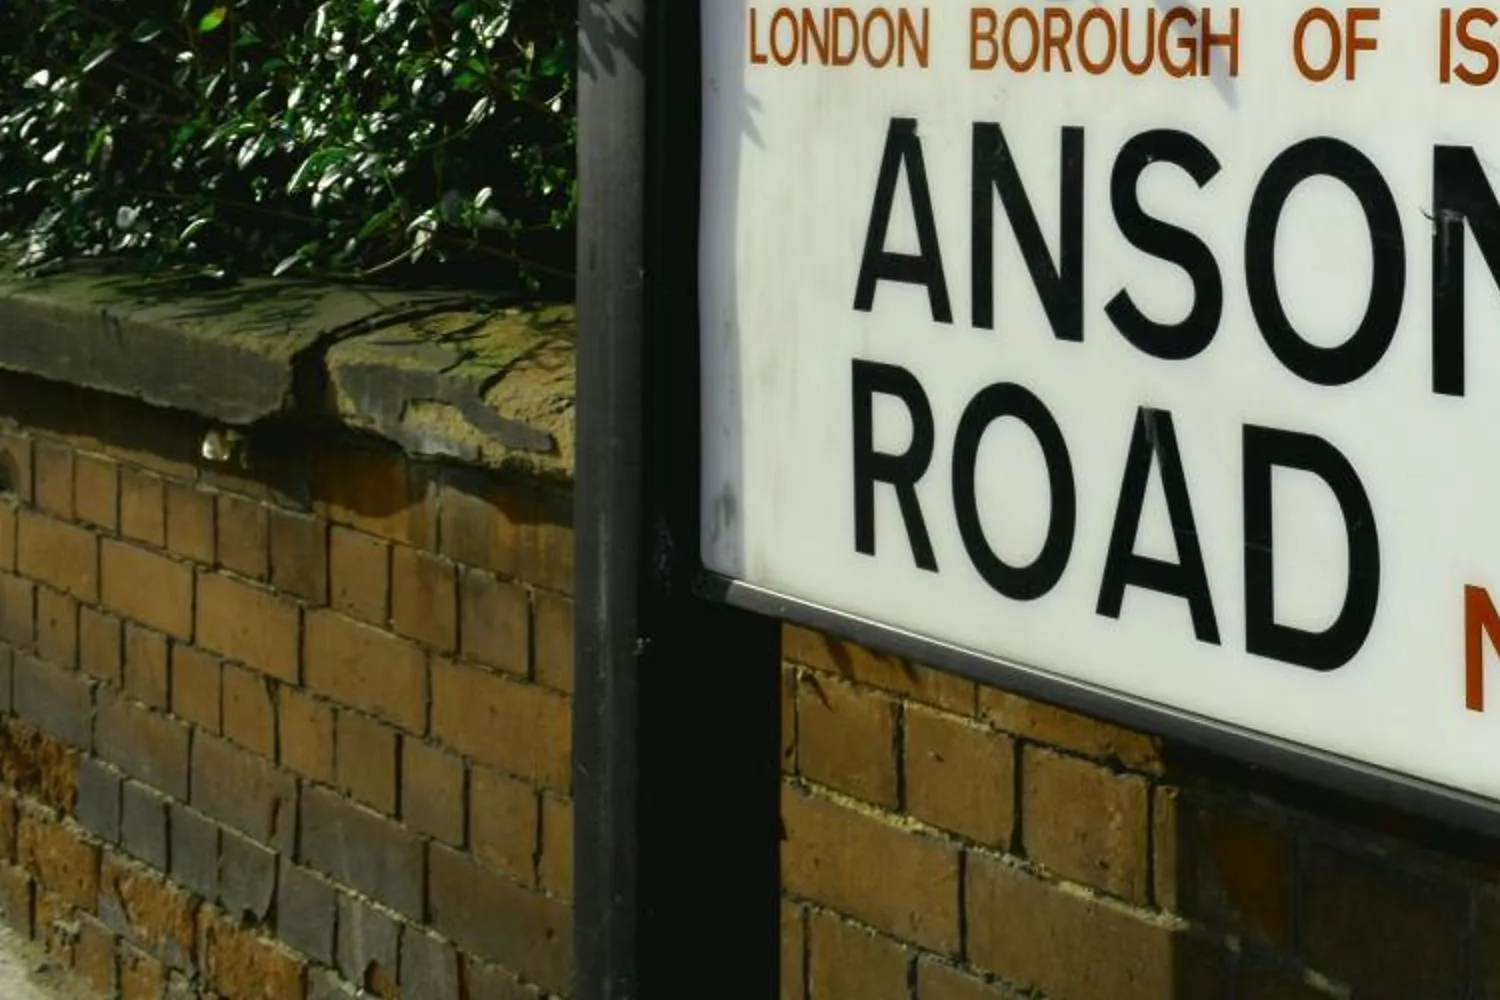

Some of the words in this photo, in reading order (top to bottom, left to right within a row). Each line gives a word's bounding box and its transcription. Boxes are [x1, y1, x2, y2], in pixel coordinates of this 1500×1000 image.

[749, 6, 931, 69] LONDON
[968, 6, 1241, 78] BOROUGH
[1293, 6, 1381, 83] OF
[851, 358, 1382, 673] ROAD
